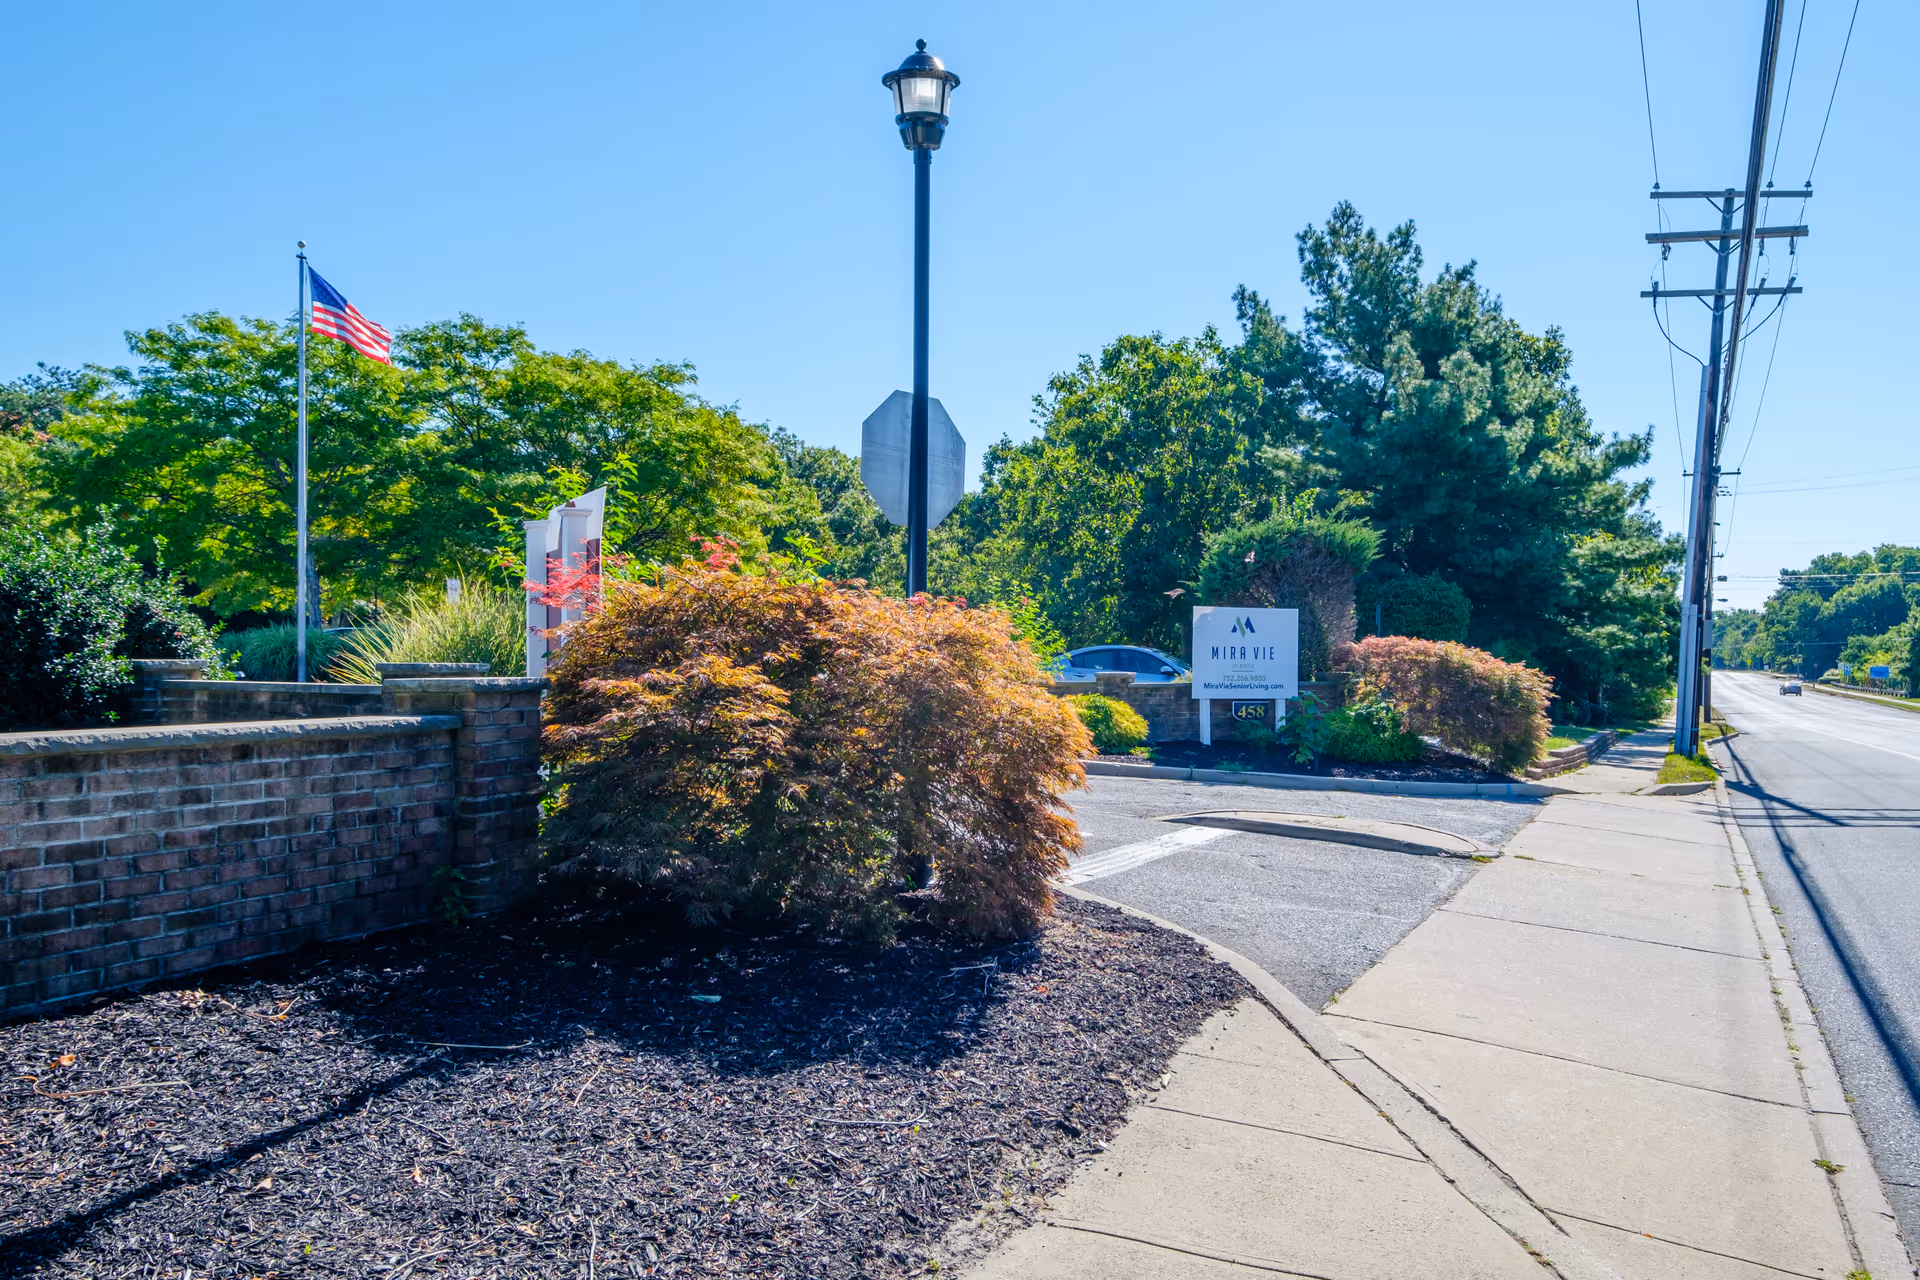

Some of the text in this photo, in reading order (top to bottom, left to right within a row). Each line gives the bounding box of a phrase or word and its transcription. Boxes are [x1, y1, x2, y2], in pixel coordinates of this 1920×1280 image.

[1211, 646, 1275, 660] MIRA VIE
[1203, 682, 1284, 691] MiraVieSeniorLiving.com
[1237, 705, 1265, 718] 458
